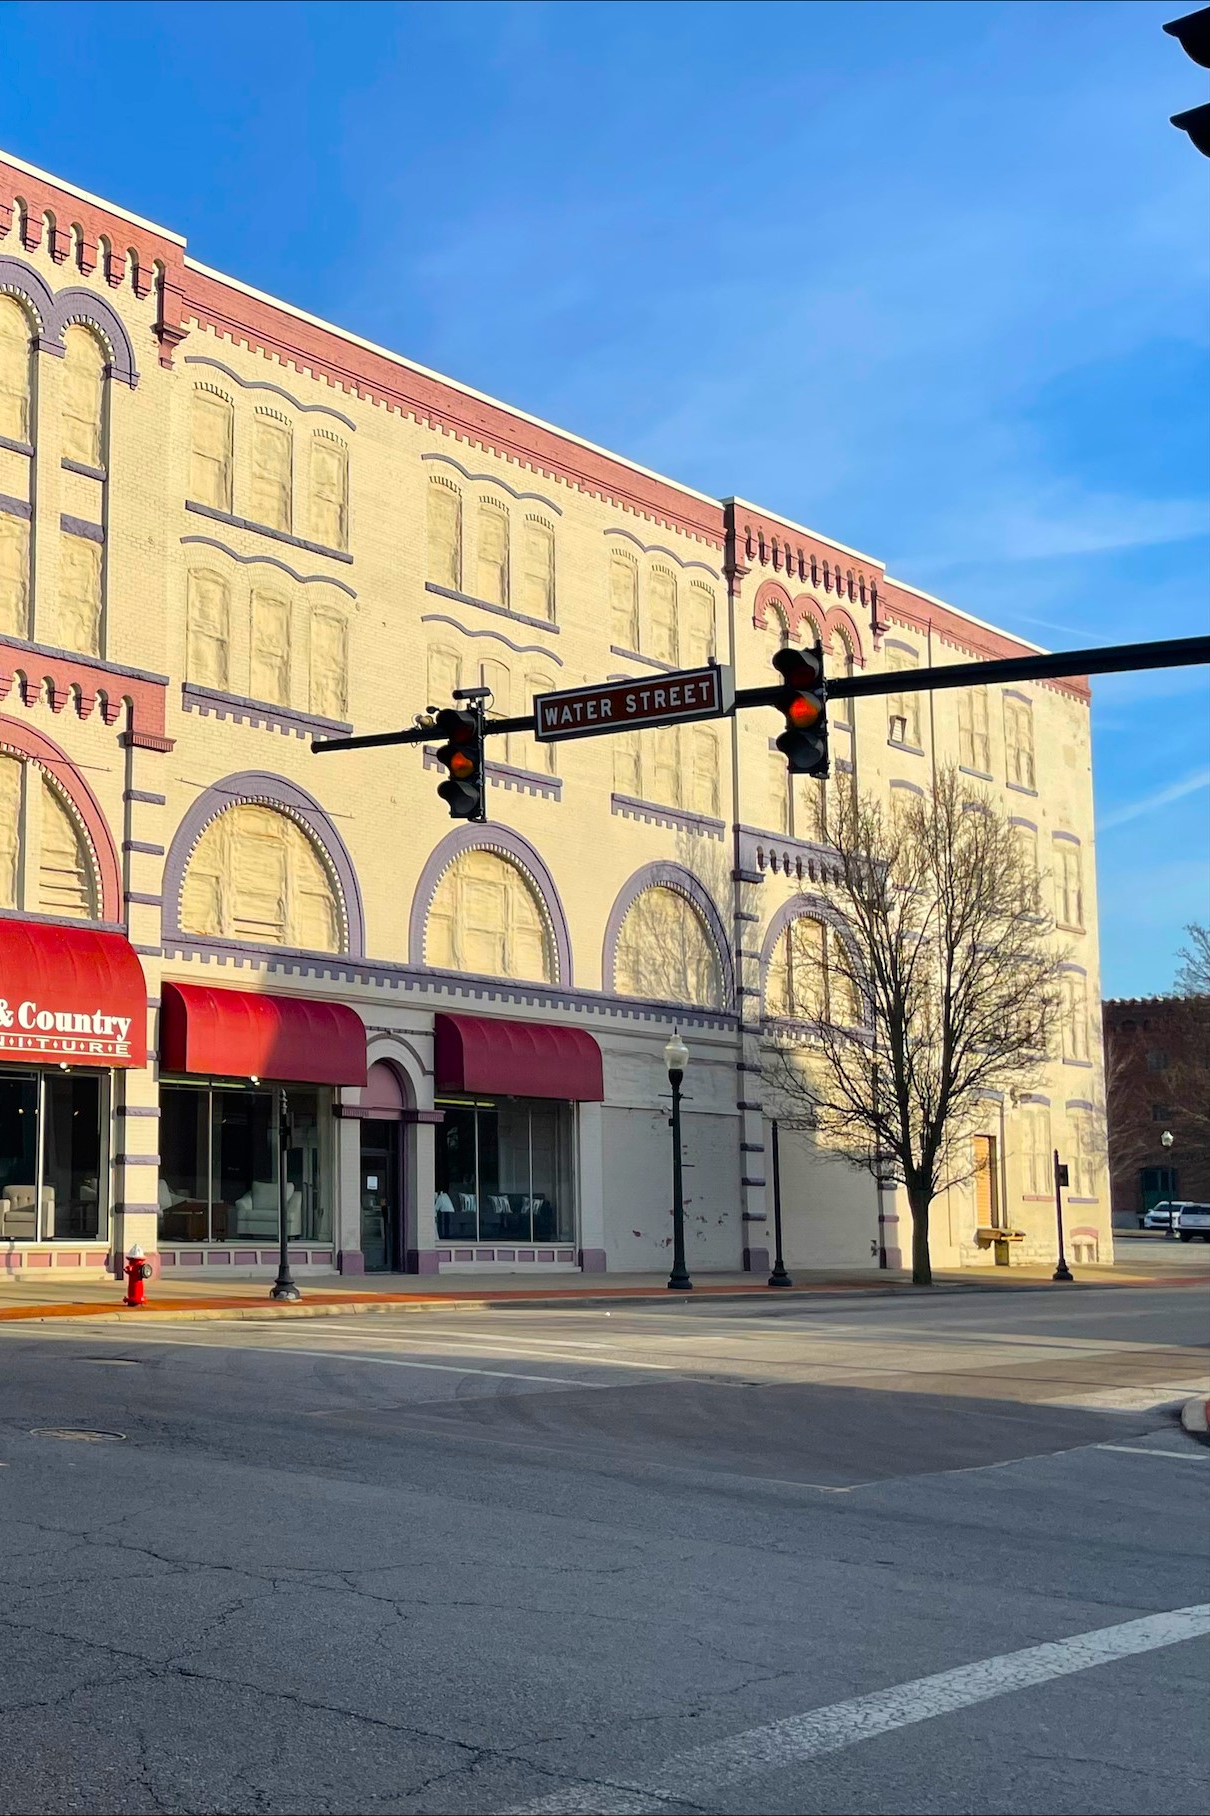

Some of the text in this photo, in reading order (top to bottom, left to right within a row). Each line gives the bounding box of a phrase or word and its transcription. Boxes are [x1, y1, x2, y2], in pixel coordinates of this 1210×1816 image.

[544, 681, 710, 727] WATER STREET
[18, 1001, 132, 1042] Country
